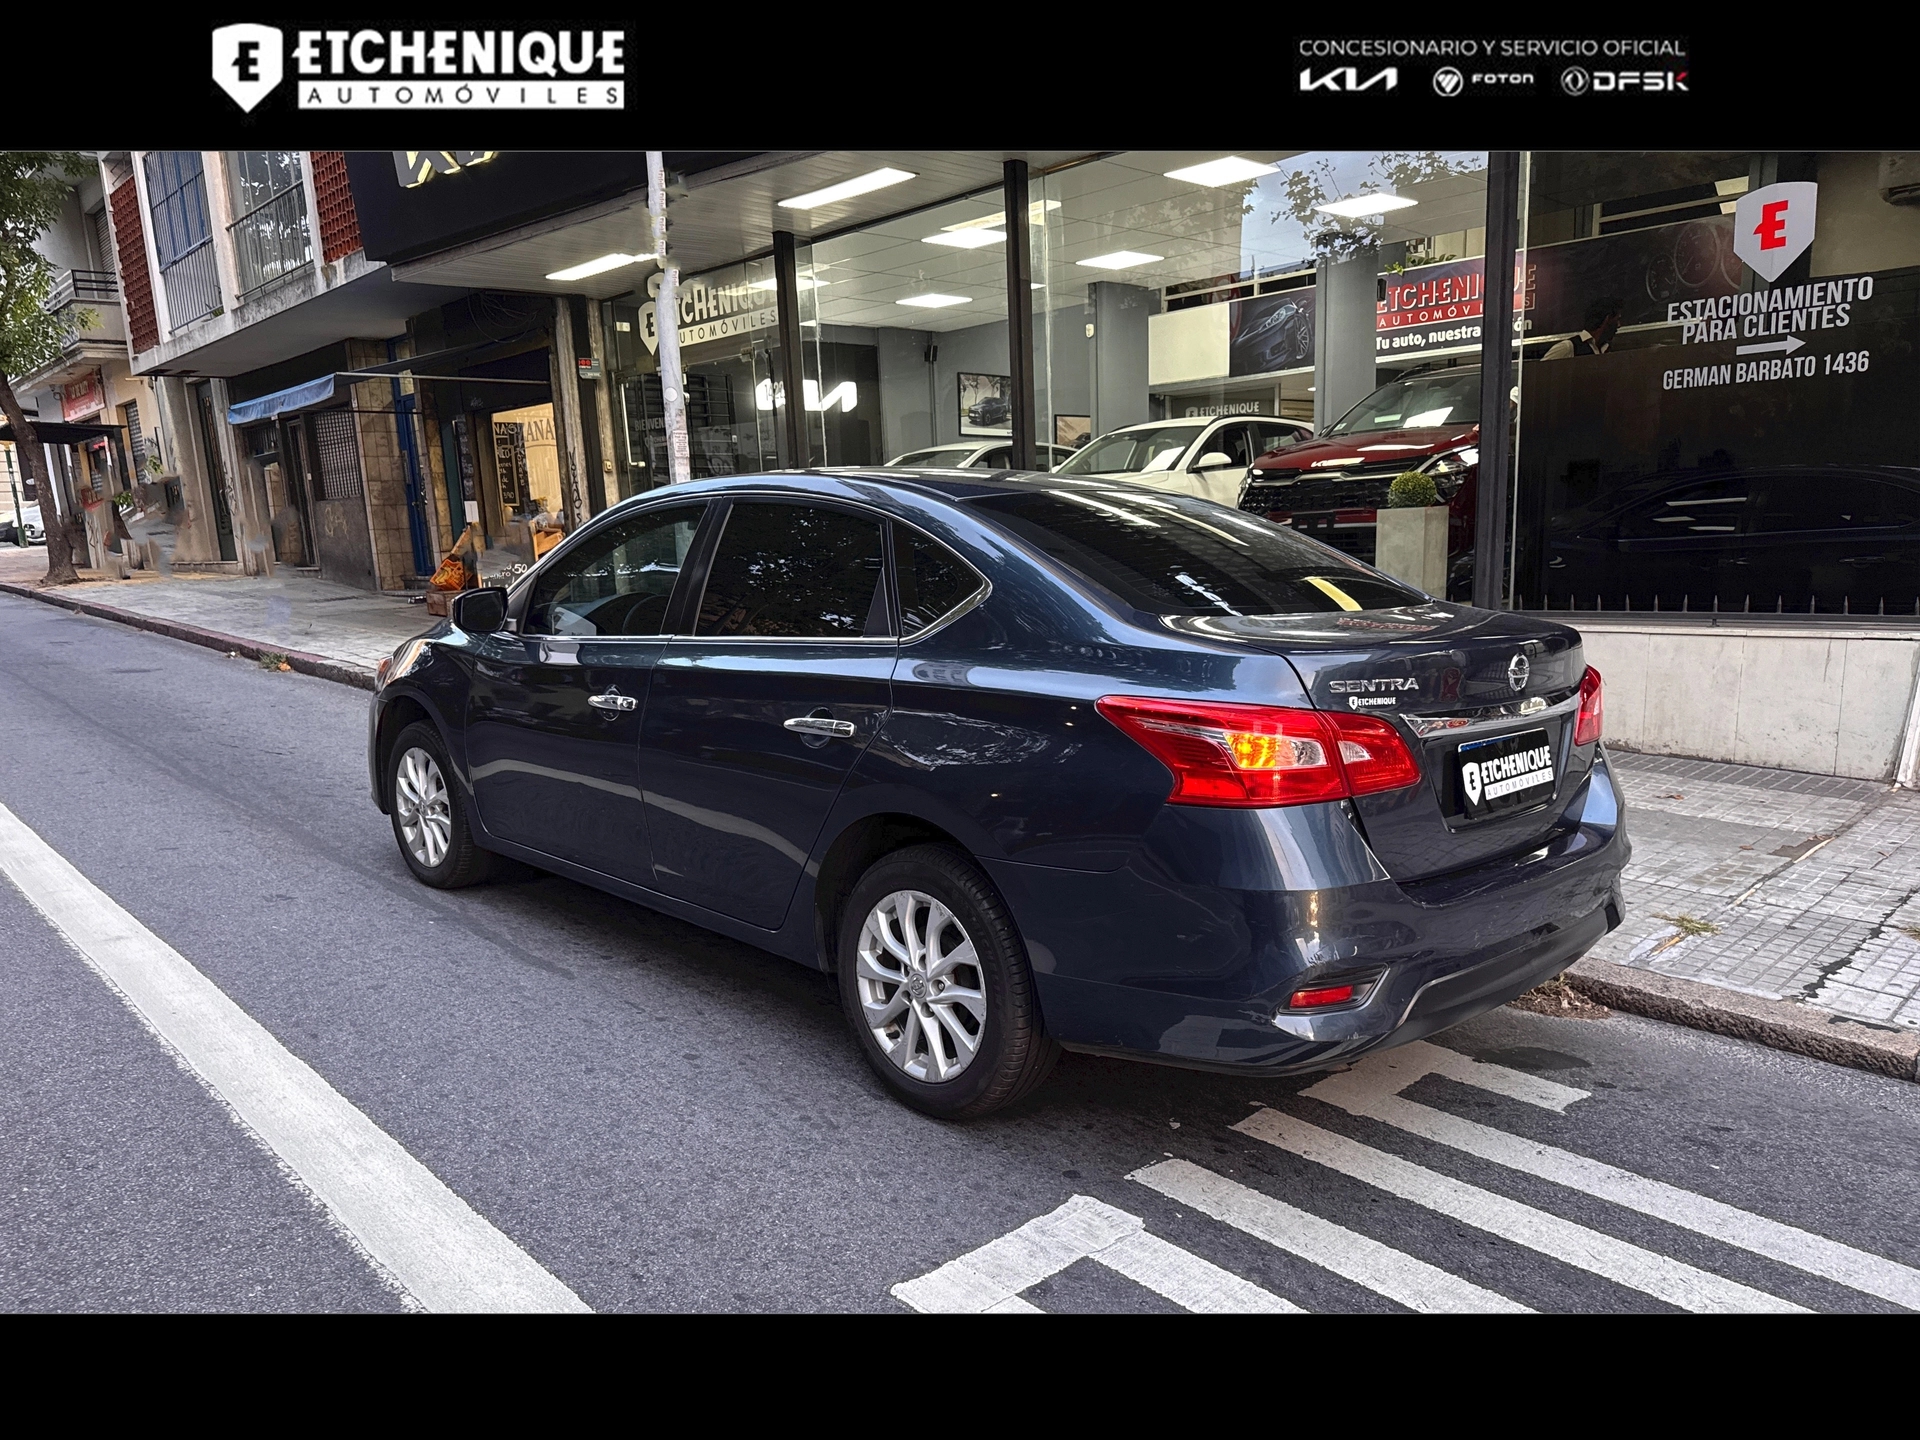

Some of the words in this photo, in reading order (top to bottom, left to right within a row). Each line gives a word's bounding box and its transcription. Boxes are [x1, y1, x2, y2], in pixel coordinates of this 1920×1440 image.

[1667, 276, 1873, 325] ESTACIONAMIENTO
[680, 309, 777, 344] UTOMÓVILES
[1392, 331, 1426, 348] auto,
[1429, 326, 1482, 343] nuestra
[1682, 317, 1737, 345] PARA
[1743, 303, 1851, 339] CLIENTES
[1663, 363, 1732, 390] GERMAN
[1735, 355, 1816, 384] BARBATO
[1823, 350, 1870, 375] 1436
[1200, 401, 1260, 417] ETCHENIQUE
[1329, 677, 1420, 694] SENTRA
[1358, 696, 1397, 706] ETCHENIQUE
[1481, 745, 1552, 784] ETCHENIQUE
